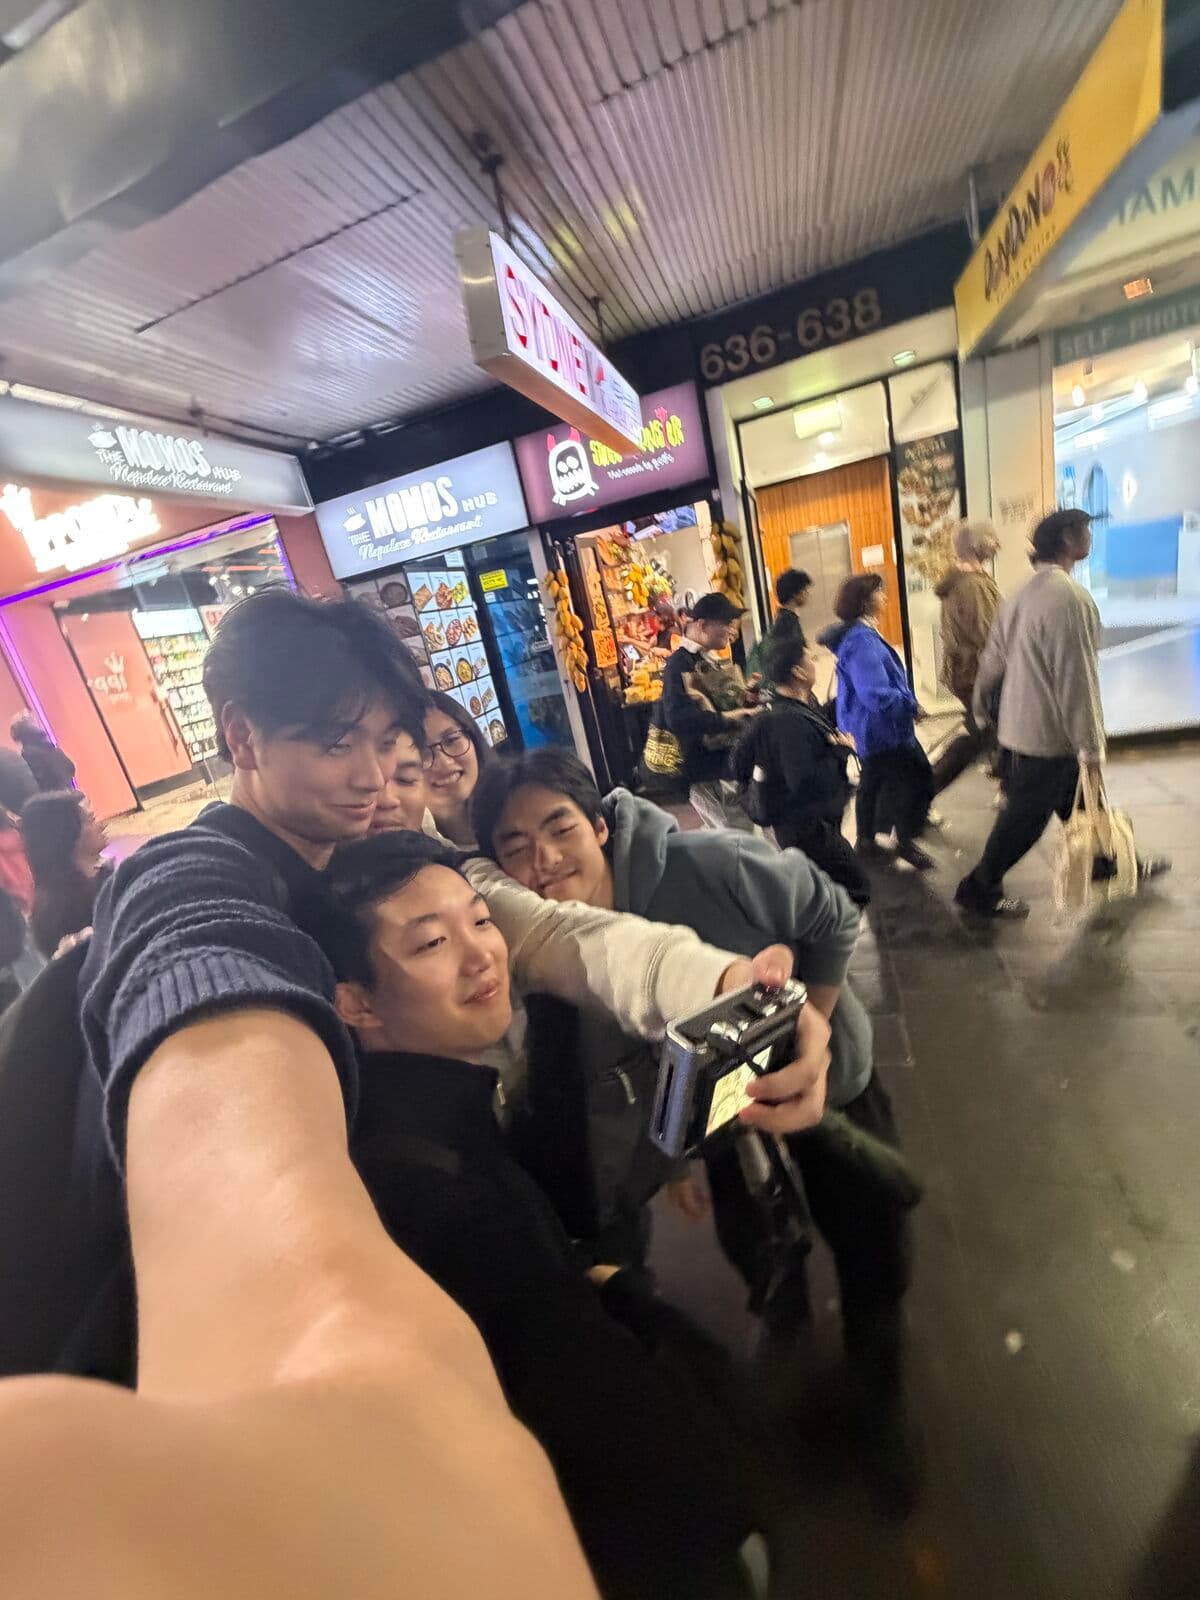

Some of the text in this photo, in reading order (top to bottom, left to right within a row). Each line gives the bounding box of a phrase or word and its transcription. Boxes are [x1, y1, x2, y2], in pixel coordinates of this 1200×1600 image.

[701, 287, 881, 380] 636-638
[95, 426, 242, 482] THE MOMOS HUB
[348, 476, 499, 547] THE MOMOS HUB
[358, 537, 413, 561] Nepalese
